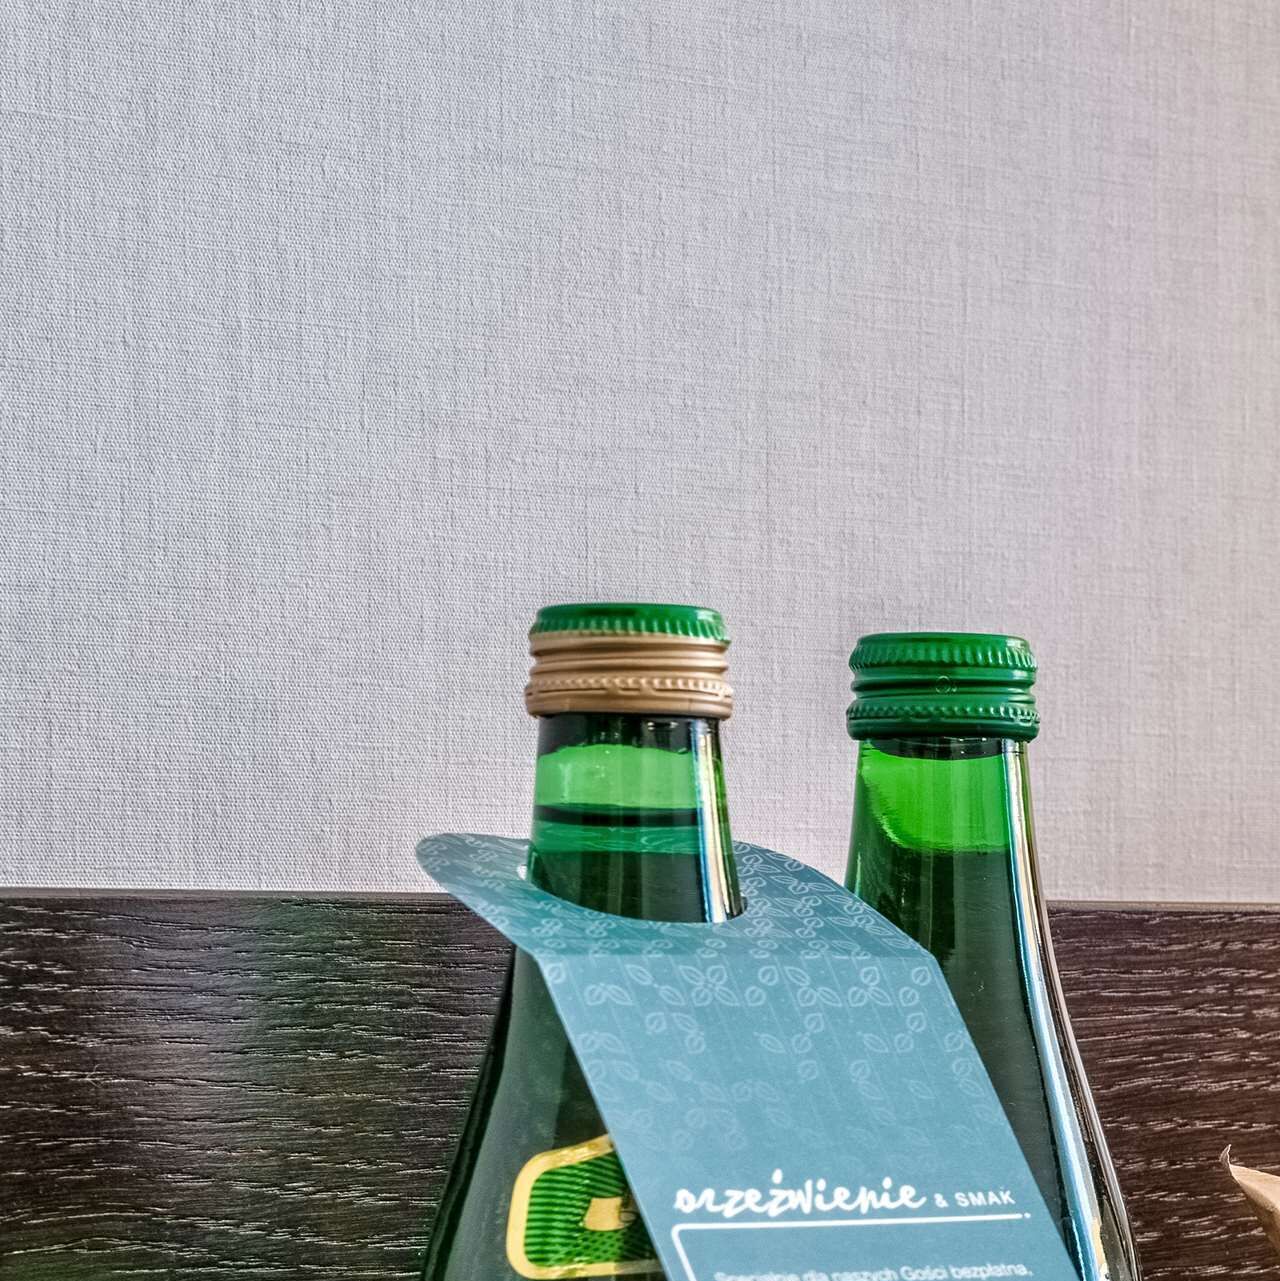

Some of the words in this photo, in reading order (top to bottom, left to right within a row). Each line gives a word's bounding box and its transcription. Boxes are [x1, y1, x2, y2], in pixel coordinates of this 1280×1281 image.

[933, 1193, 950, 1208] &
[954, 1189, 1016, 1207] SMAK
[899, 1264, 949, 1281] Gości
